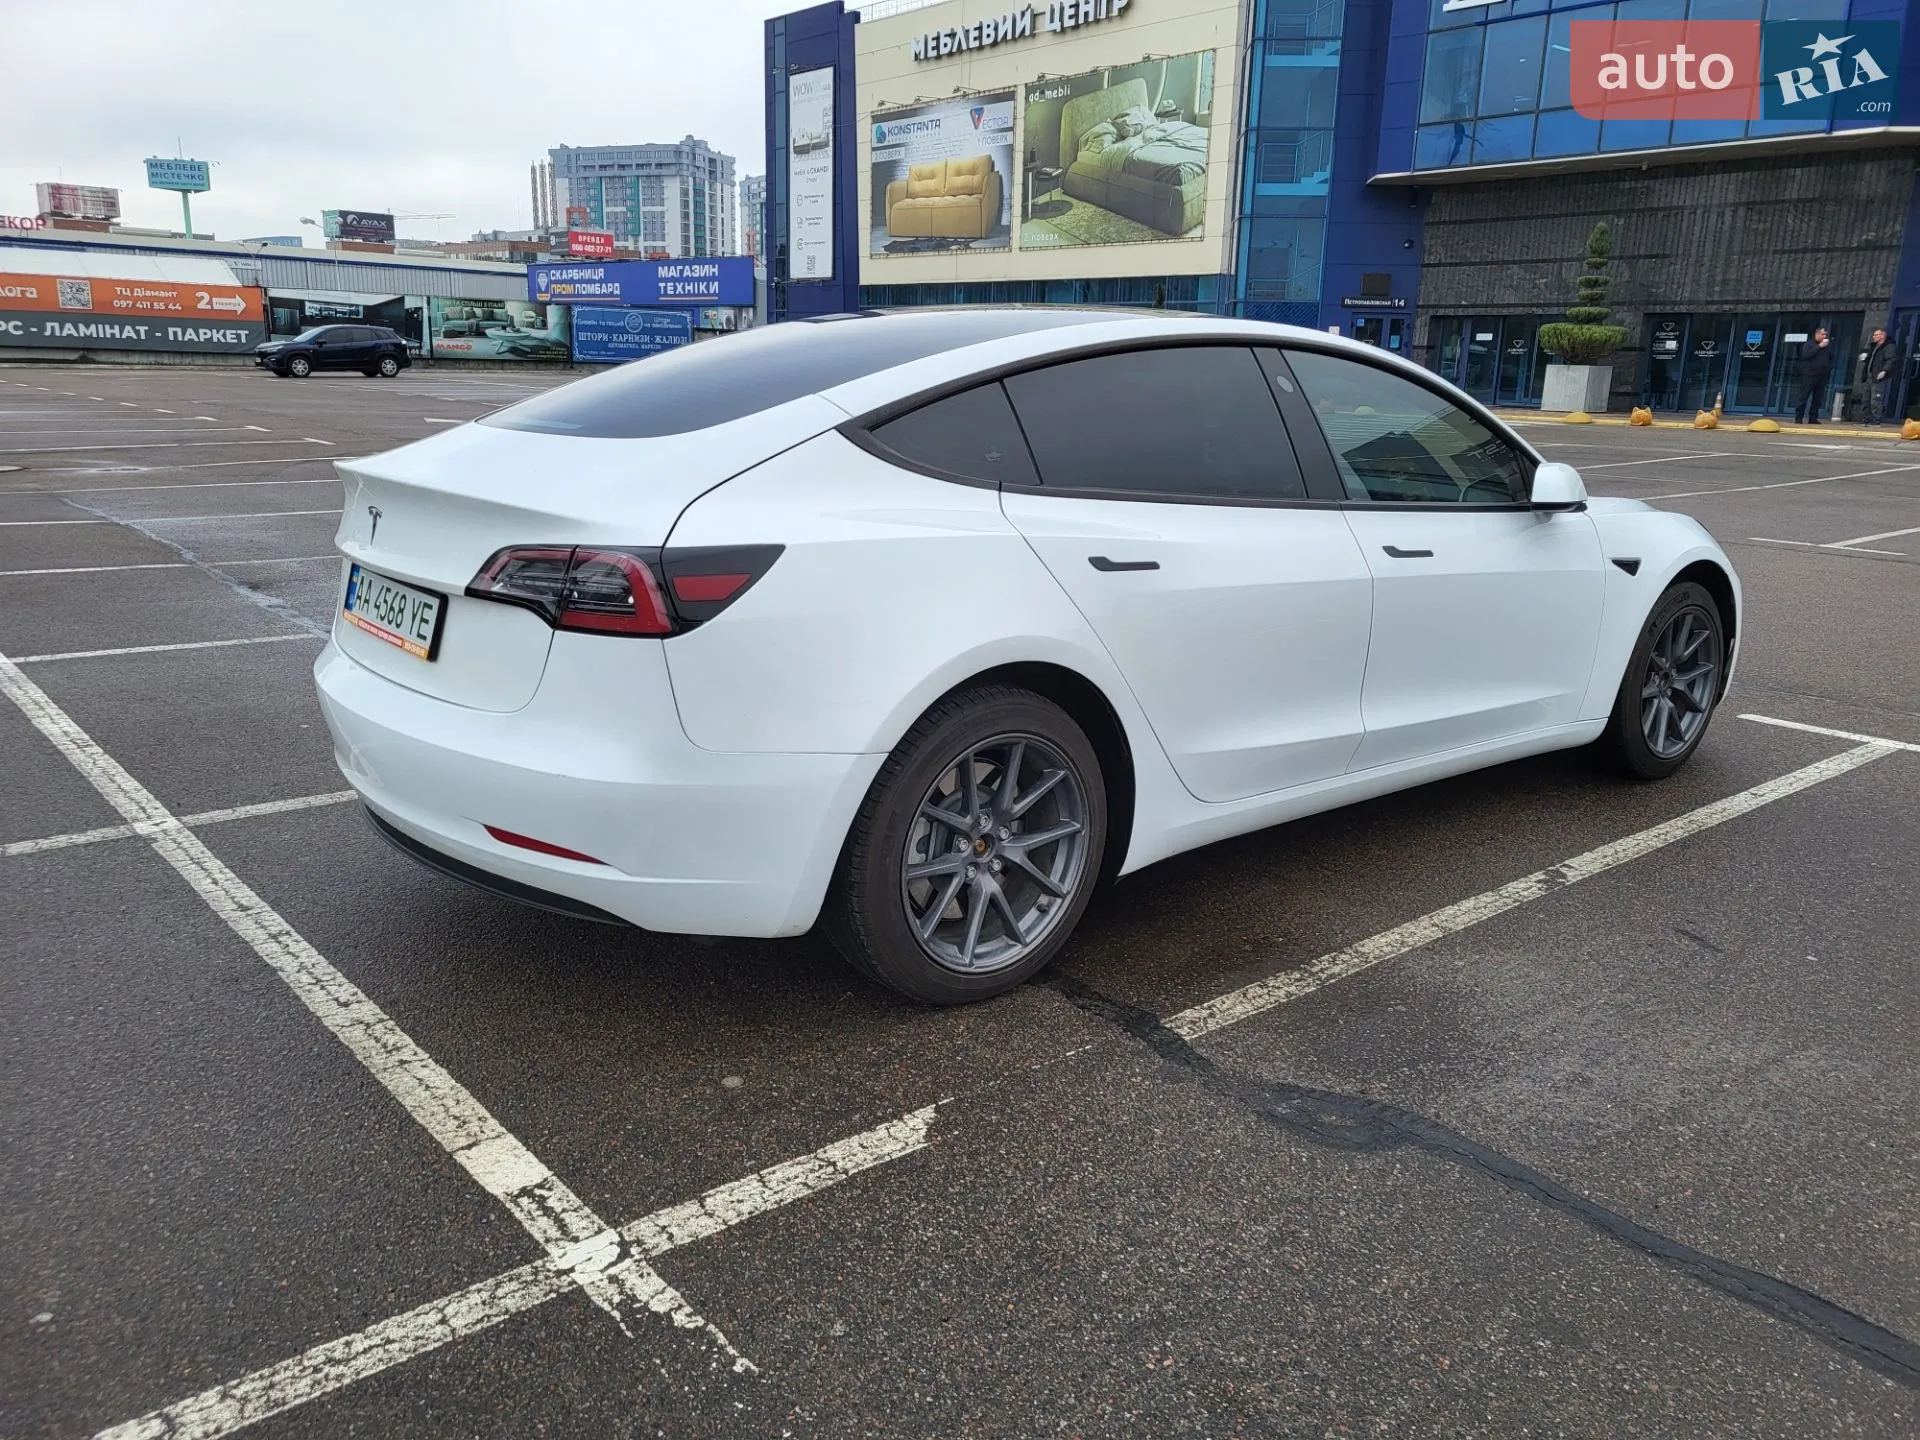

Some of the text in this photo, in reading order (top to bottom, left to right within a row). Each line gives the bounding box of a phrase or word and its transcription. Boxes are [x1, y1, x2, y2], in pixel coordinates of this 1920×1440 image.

[911, 0, 1128, 61] МЕБЛЕВИЙ ЦЕНТР
[887, 118, 941, 137] KONSTANTA
[981, 133, 1008, 146] ПОВЕРХ
[879, 150, 903, 161] ПОВЕРХ
[150, 162, 204, 172] МЕБЛЕВЕ
[151, 172, 205, 181] МІСТЕЧКО
[360, 219, 387, 228] AYAX
[578, 235, 605, 244] ОРЕНДА
[550, 264, 719, 281] СКАРБНИЦЯ МАГАЗИН
[134, 288, 178, 298] Діамант
[659, 282, 719, 295] ТЕХНІКИ
[113, 300, 182, 311] 097 411 55 44
[195, 291, 212, 310] 2
[1395, 299, 1405, 307] 14
[44, 322, 148, 340] ЛАМІНАТ
[168, 327, 250, 343] ПАРКЕТ
[578, 332, 609, 341] ШТОРИ
[613, 334, 650, 344] КАРНИЗИ
[356, 575, 372, 614] AA
[374, 585, 407, 628] 4568
[409, 597, 433, 641] YE
